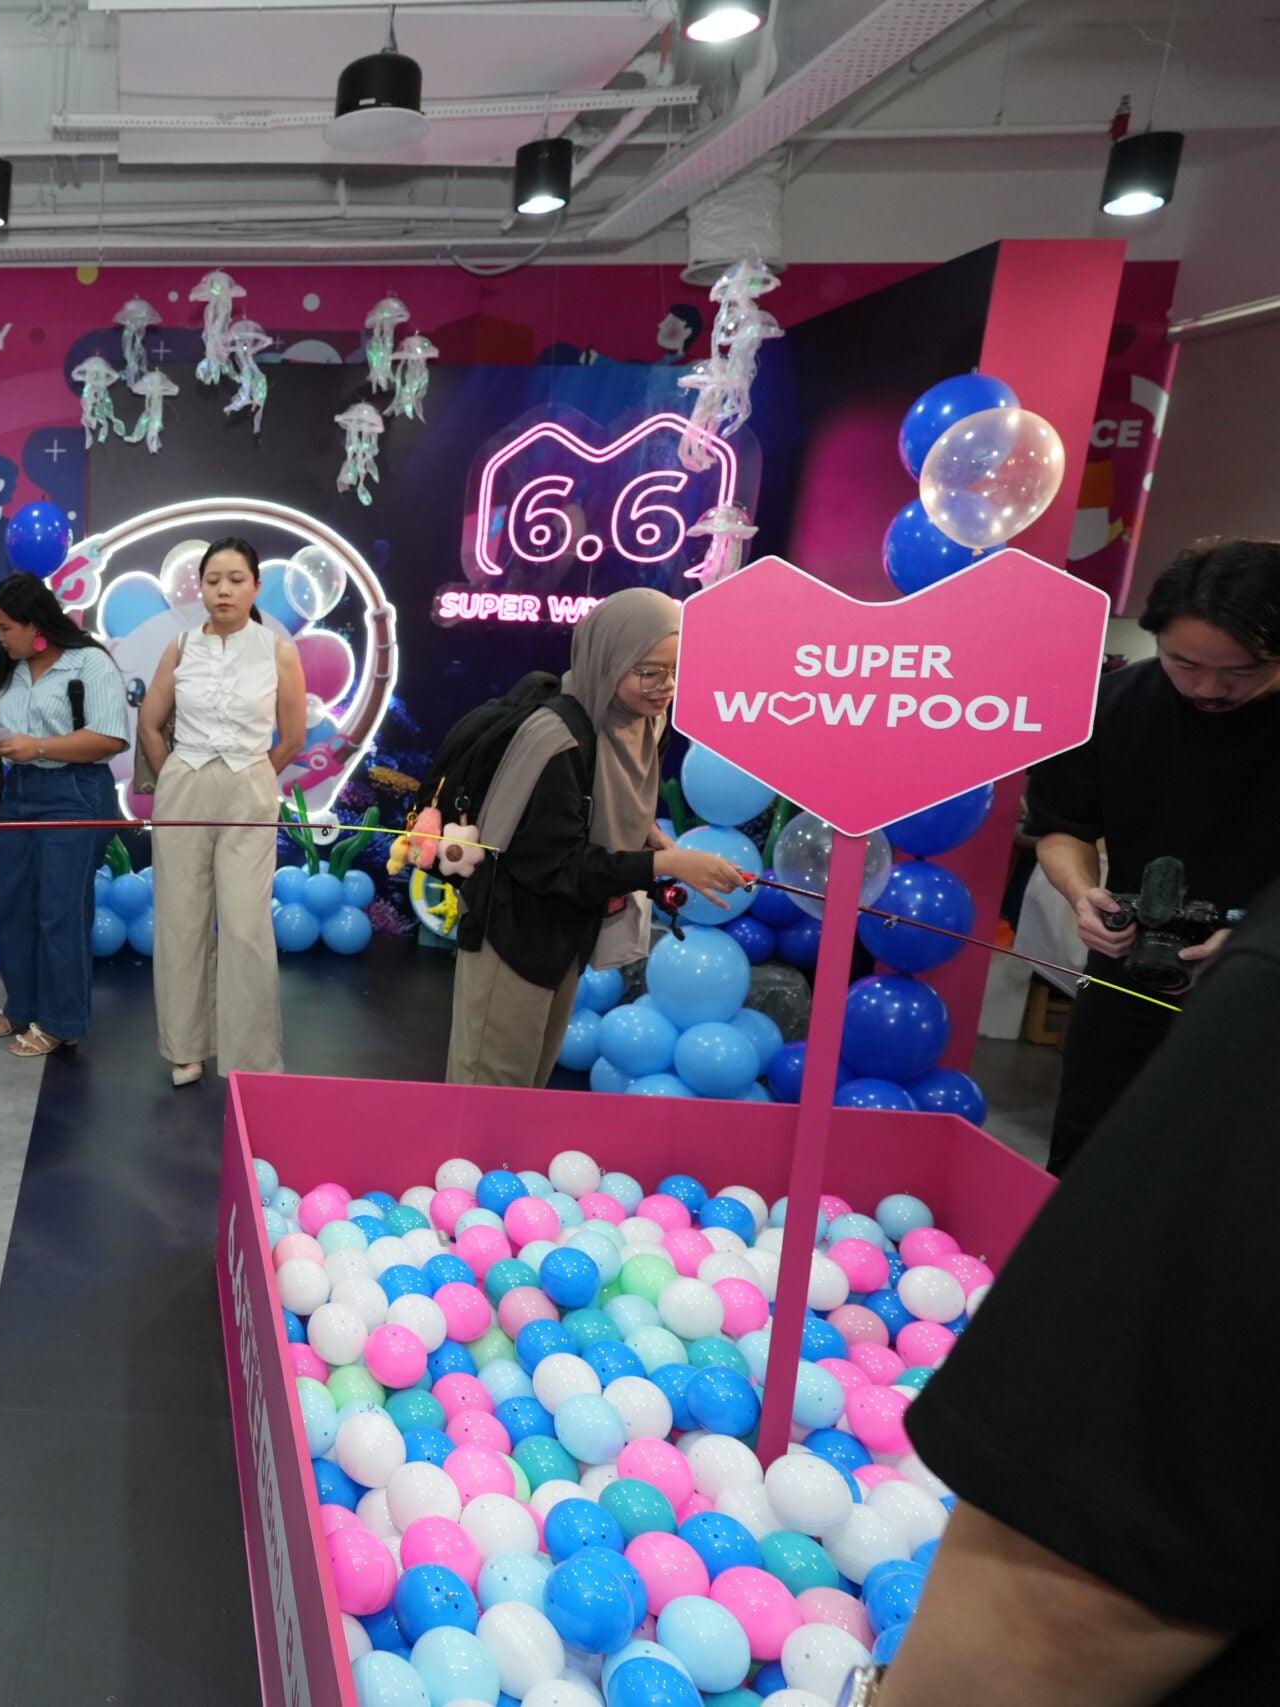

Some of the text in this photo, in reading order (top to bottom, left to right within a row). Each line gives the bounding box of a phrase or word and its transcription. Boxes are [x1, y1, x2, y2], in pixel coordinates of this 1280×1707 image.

[508, 470, 688, 563] 6.6
[439, 591, 541, 623] SUPER
[793, 644, 954, 679] SUPER
[886, 694, 1042, 732] POOL
[240, 1303, 261, 1471] SALE
